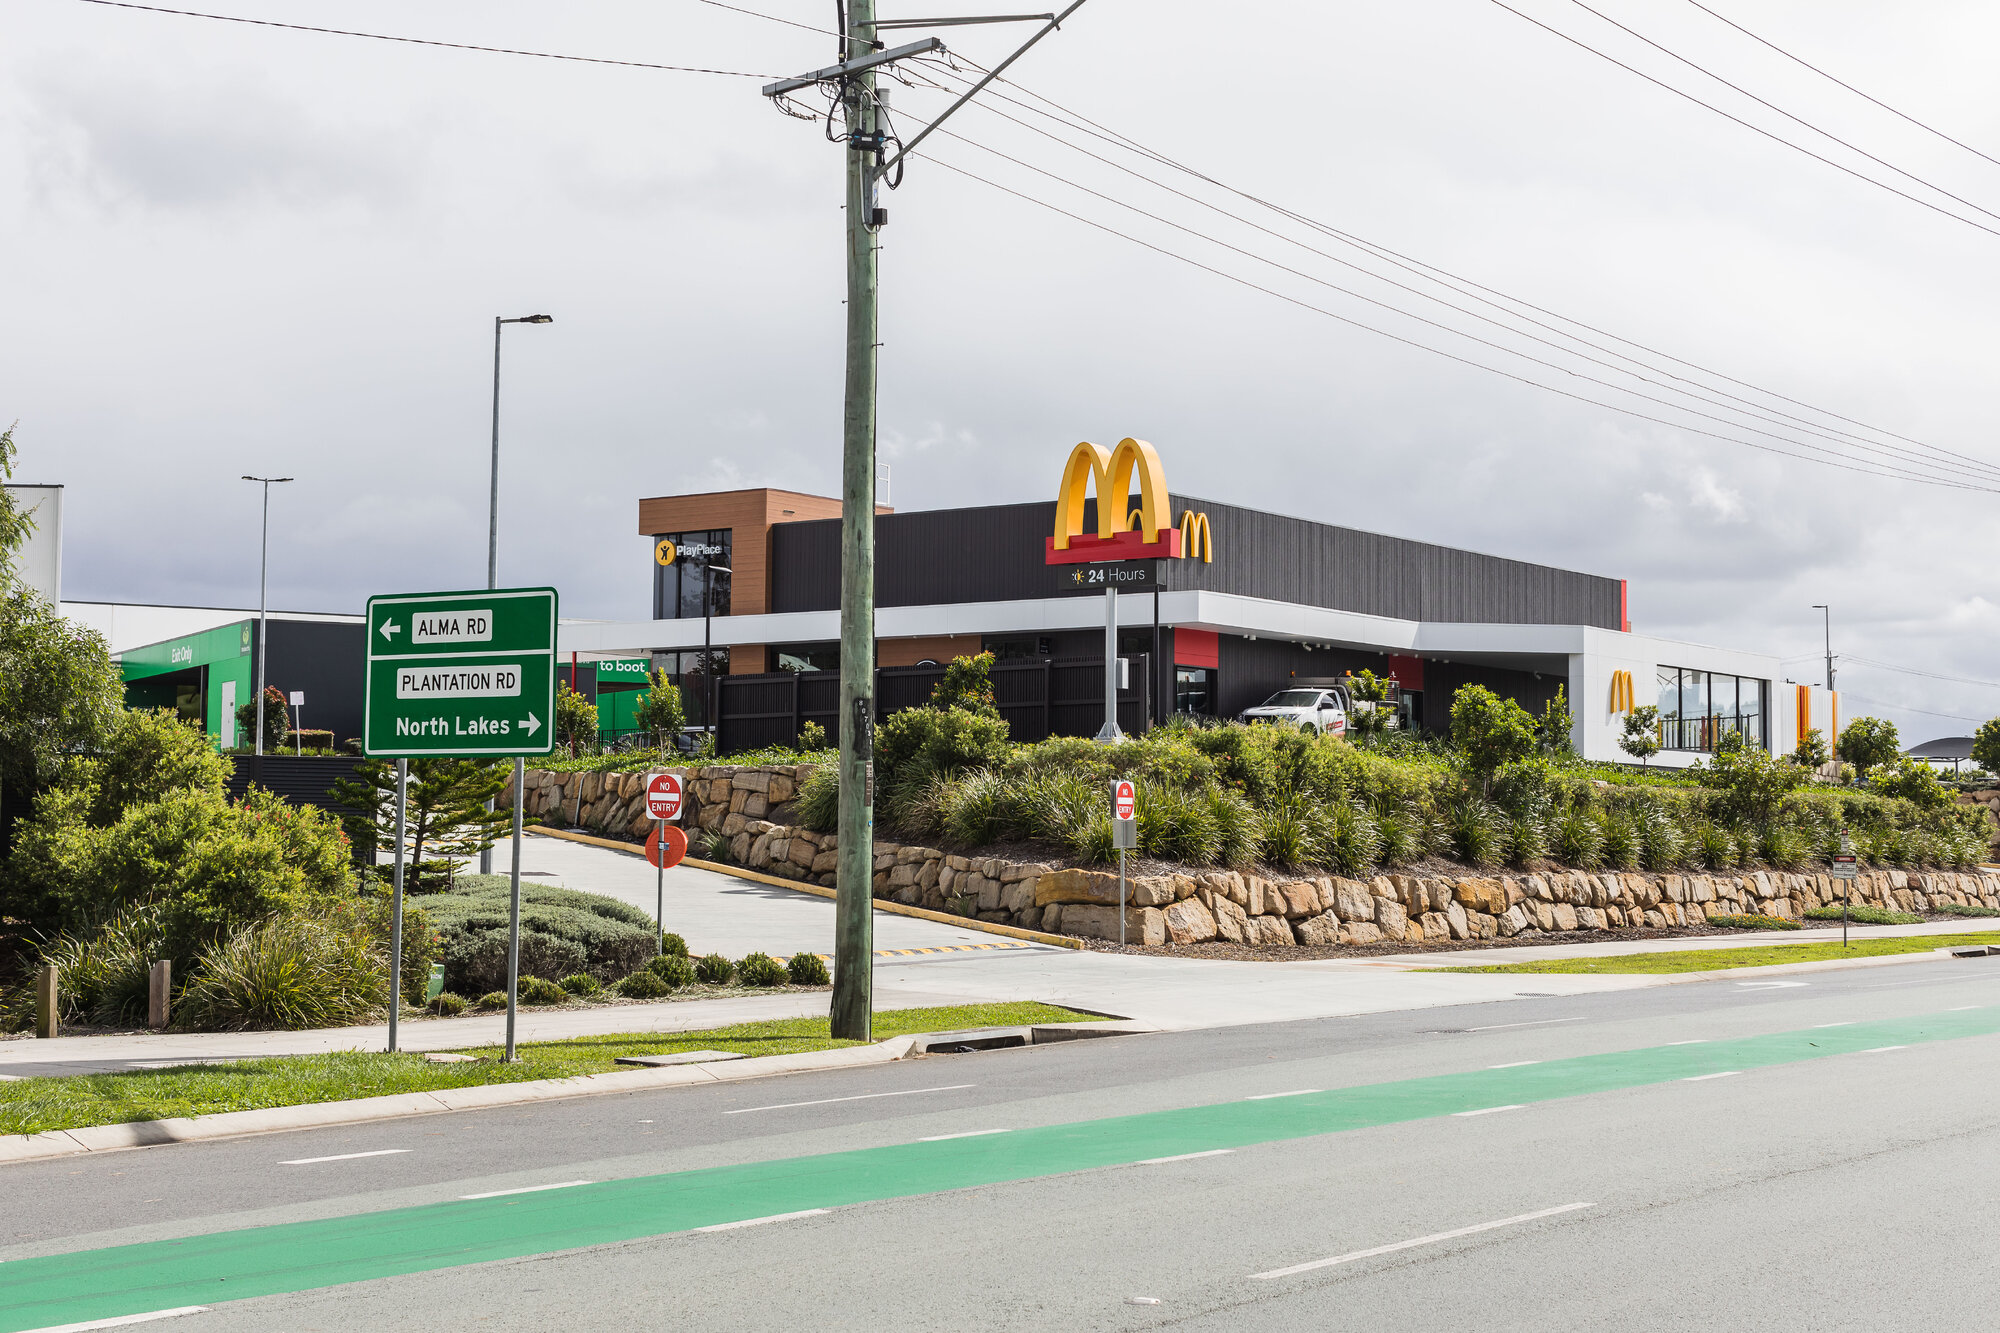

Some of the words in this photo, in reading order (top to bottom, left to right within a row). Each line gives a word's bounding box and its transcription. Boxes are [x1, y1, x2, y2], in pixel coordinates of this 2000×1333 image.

[676, 543, 721, 557] PlayPlace
[1088, 569, 1105, 583] 24
[1108, 567, 1145, 582] Hours
[418, 618, 460, 636] ALMA
[467, 617, 487, 635] RD
[171, 648, 180, 663] Exit
[181, 645, 192, 664] Only
[599, 660, 613, 671] to
[616, 660, 646, 673] boot
[402, 672, 491, 692] PLANTATION
[496, 672, 516, 690] RD
[396, 716, 449, 737] North
[455, 715, 510, 735] Lakes
[660, 782, 670, 791] NO
[1122, 788, 1128, 796] NO
[651, 802, 676, 812] ENTRY
